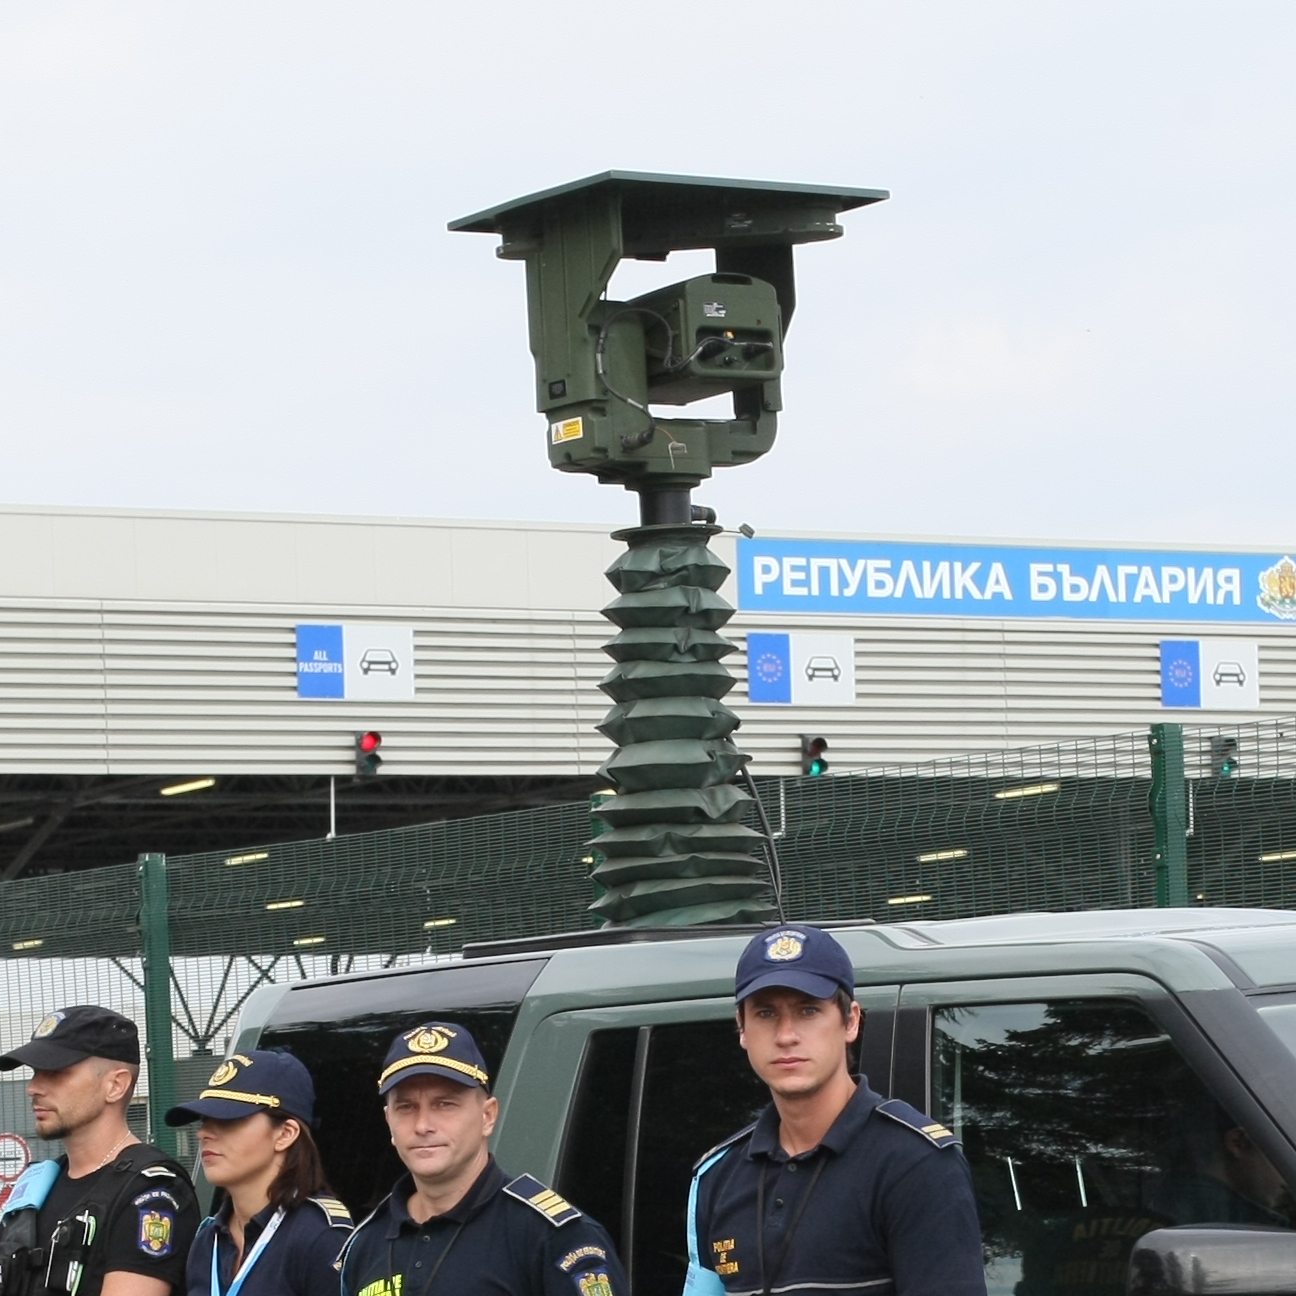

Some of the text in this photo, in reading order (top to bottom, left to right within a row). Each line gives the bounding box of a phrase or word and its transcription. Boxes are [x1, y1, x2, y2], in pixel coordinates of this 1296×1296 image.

[753, 555, 1241, 605] РЕПУБЛИКА БЪЛГАРИЯ
[313, 650, 329, 661] ALL
[298, 662, 343, 674] PASSPORTS
